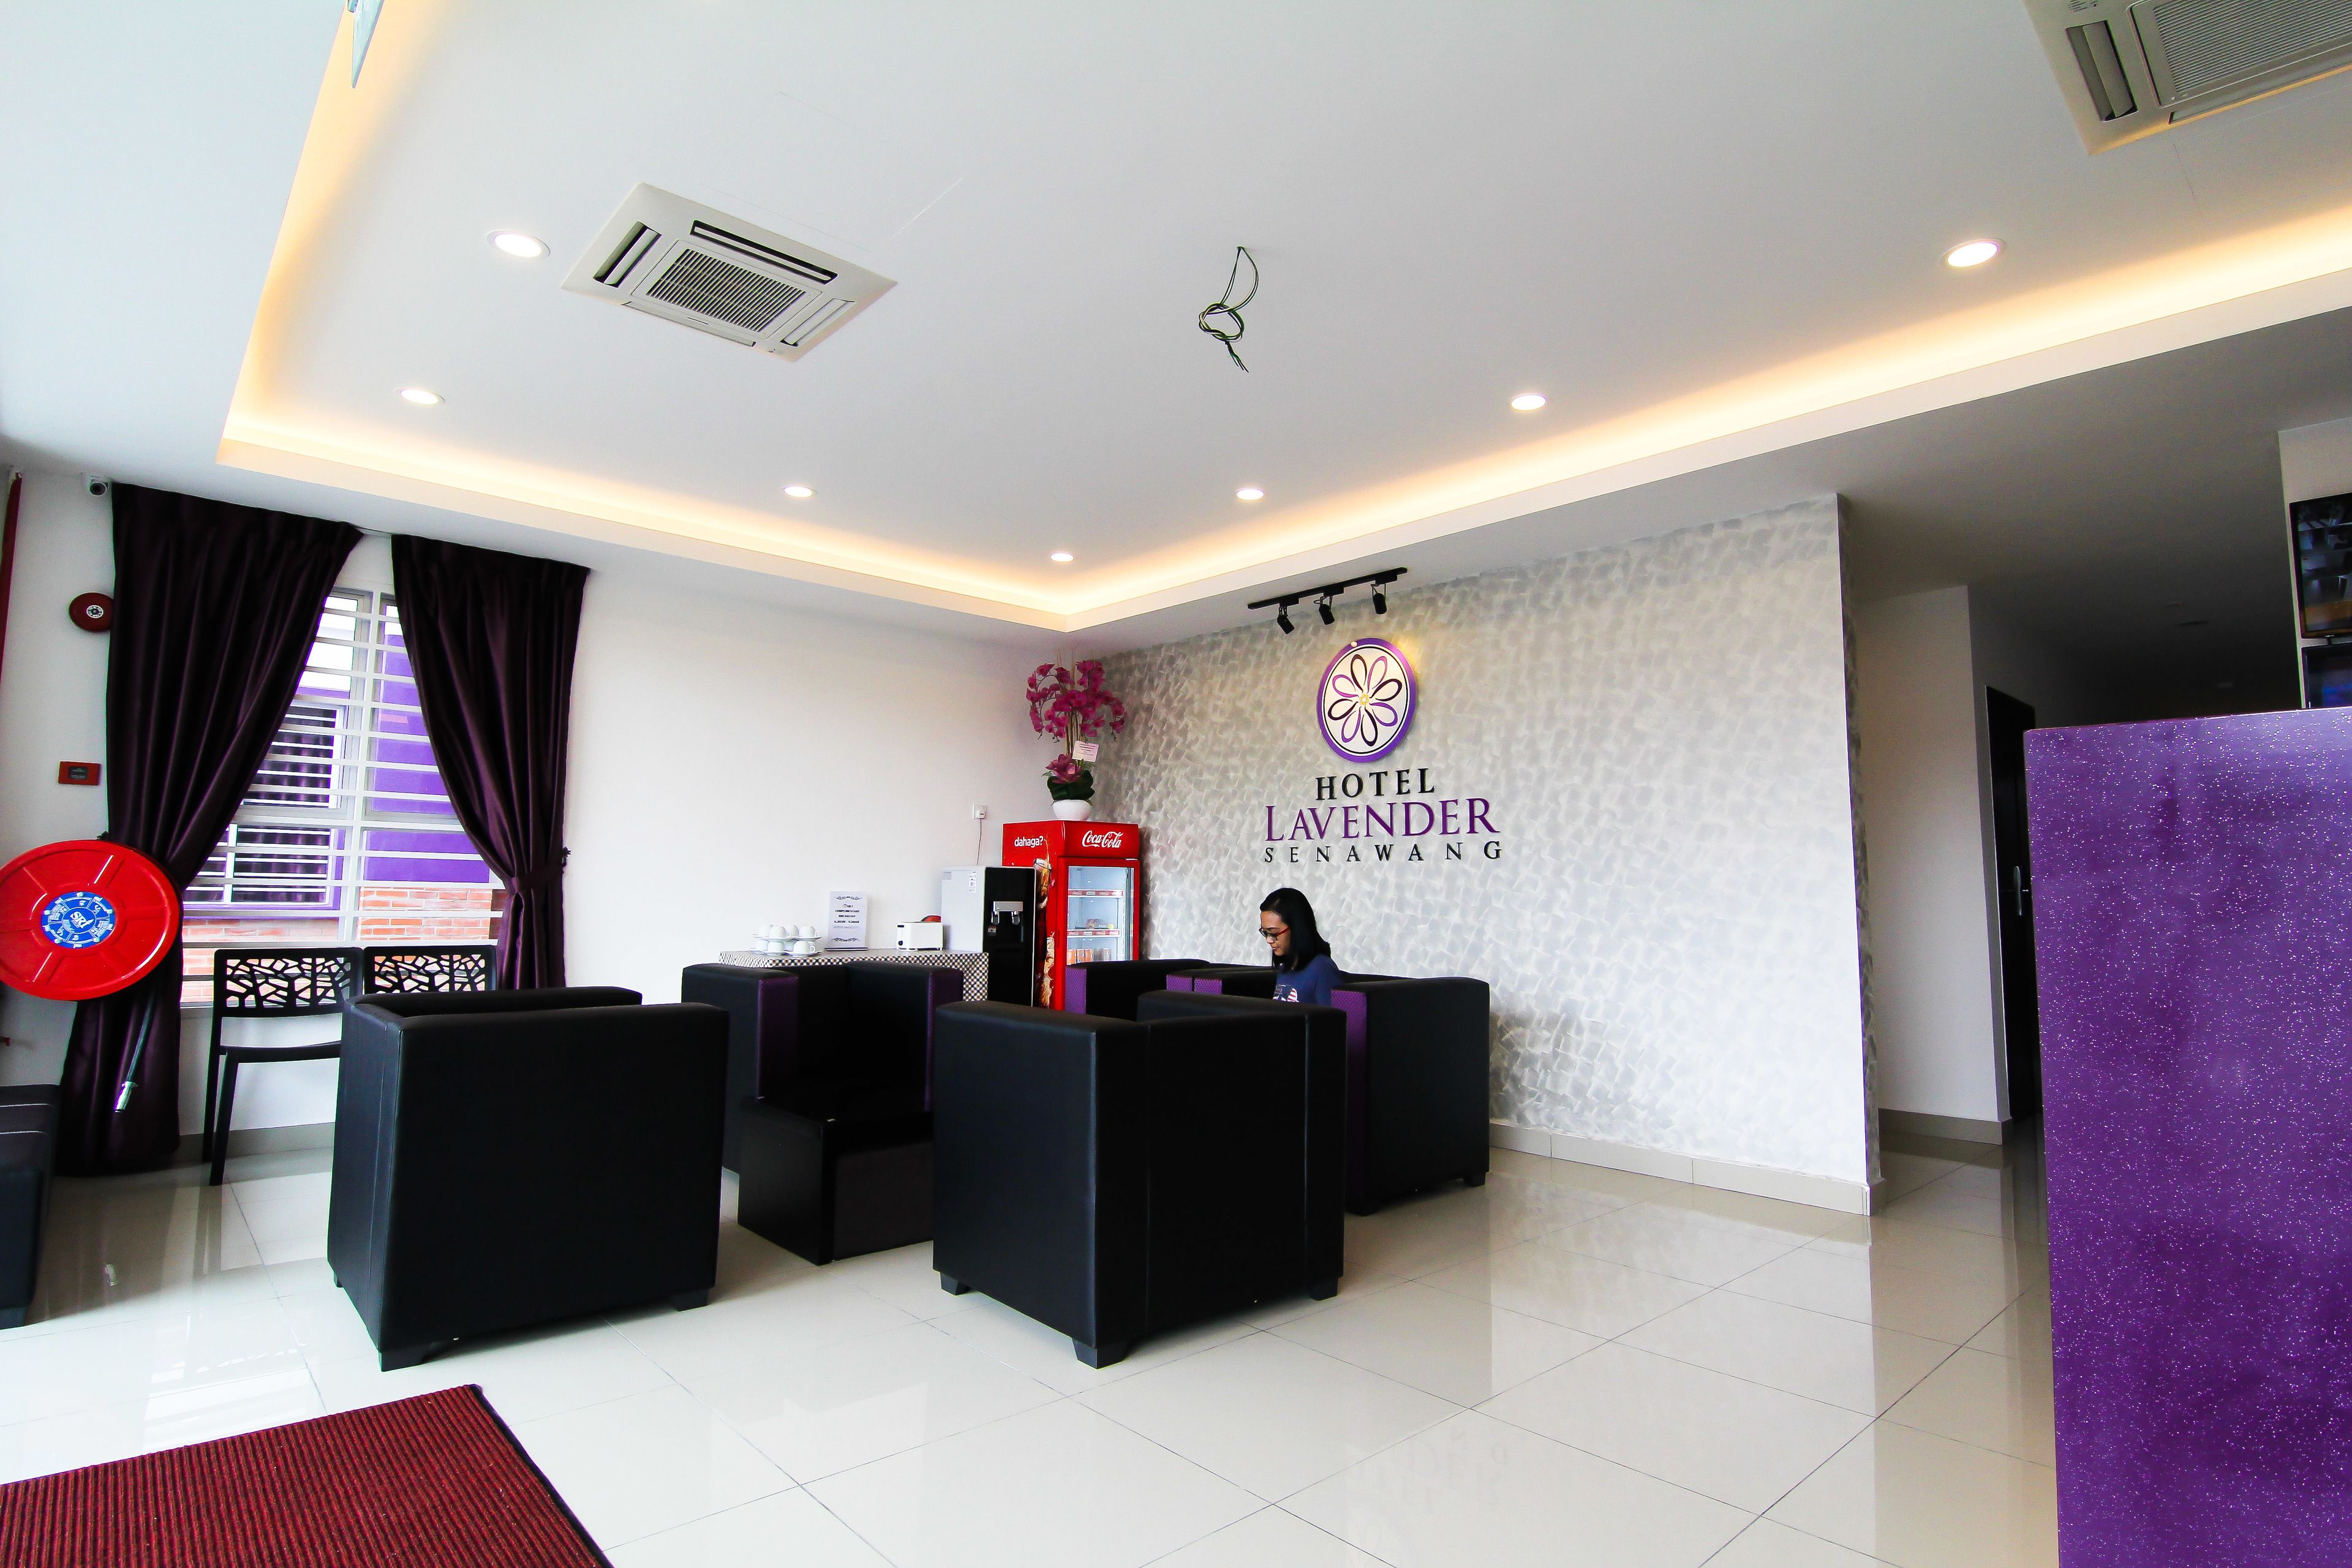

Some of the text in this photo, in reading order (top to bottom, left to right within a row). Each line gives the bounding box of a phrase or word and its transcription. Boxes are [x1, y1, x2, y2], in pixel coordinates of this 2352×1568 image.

[1315, 767, 1436, 801] HOTEL
[1265, 797, 1501, 842] LAVENDER
[1014, 835, 1044, 848] dahaga?
[1082, 830, 1123, 848] Coca-Cola
[1264, 840, 1502, 863] SENAWANG
